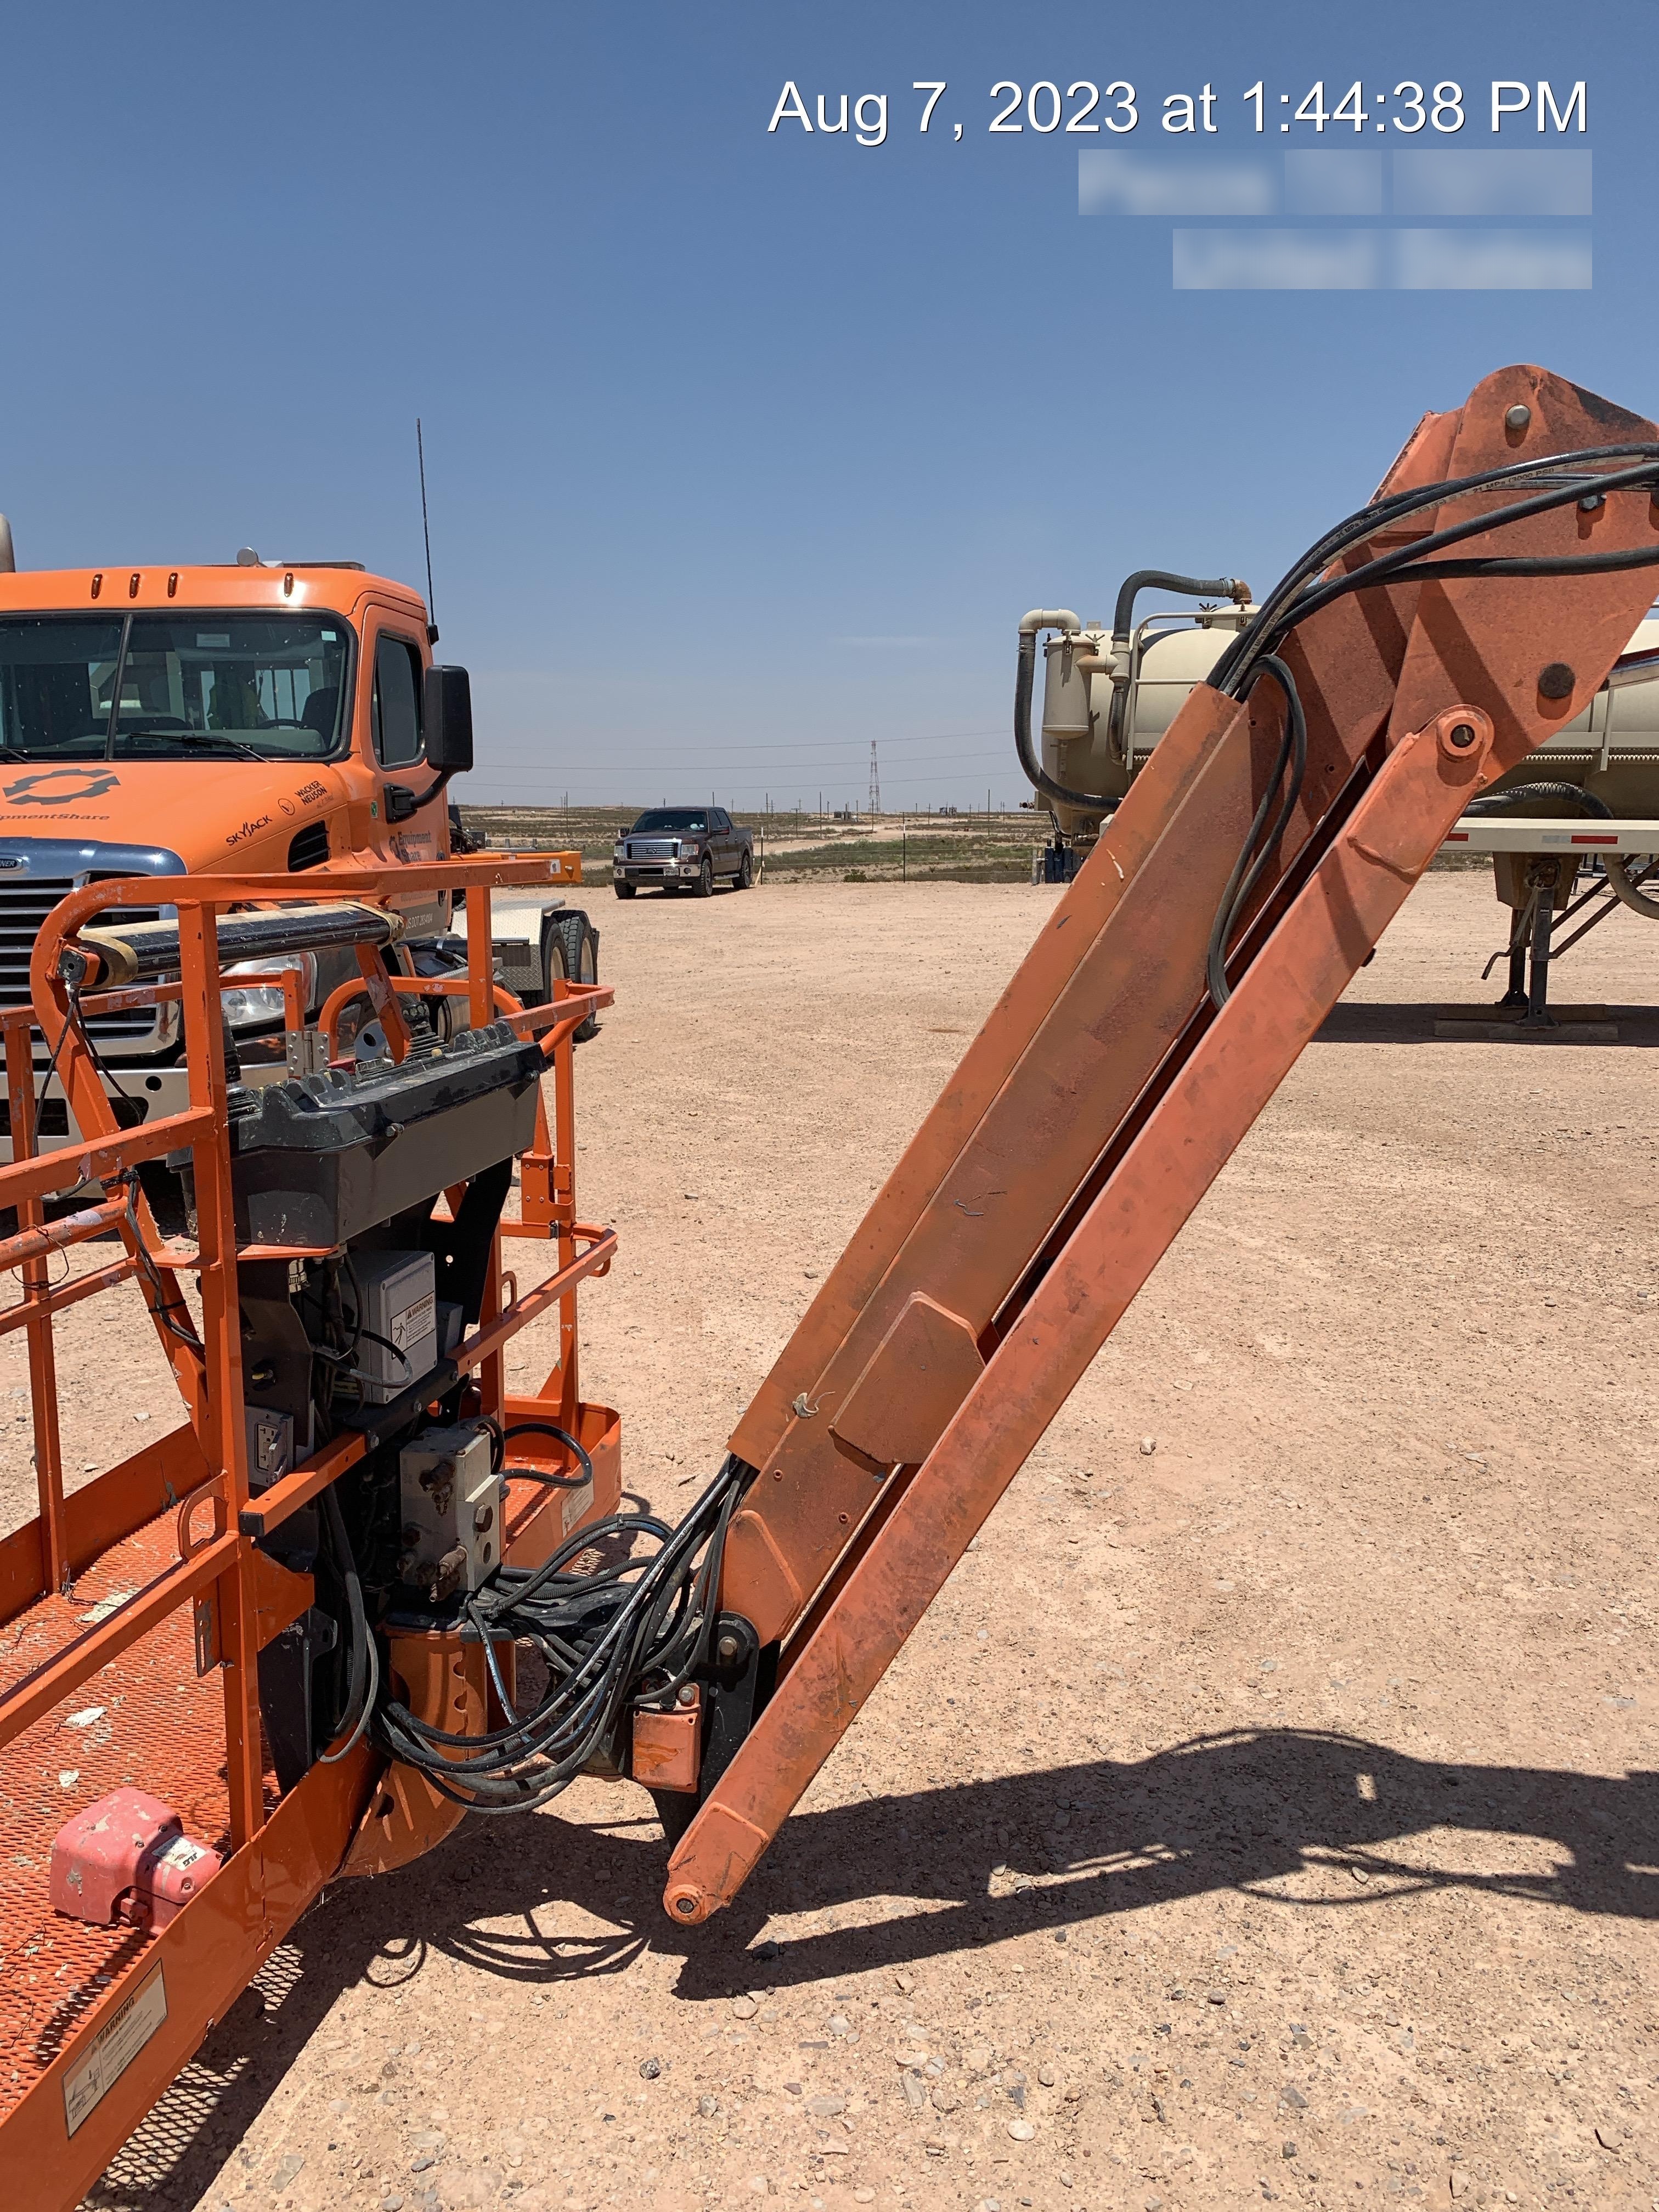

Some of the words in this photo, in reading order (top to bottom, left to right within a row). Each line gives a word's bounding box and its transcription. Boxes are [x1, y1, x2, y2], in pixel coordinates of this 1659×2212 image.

[295, 781, 322, 798] WACKER
[301, 786, 328, 805] NEUSON
[225, 815, 273, 846] SKYJACK
[398, 830, 432, 848] Equipment
[411, 1296, 433, 1316] WARNING
[663, 1549, 673, 1561] MPa
[672, 1536, 684, 1551] (3000
[183, 1852, 198, 1867] JLG
[97, 1996, 136, 2044] WARNING
